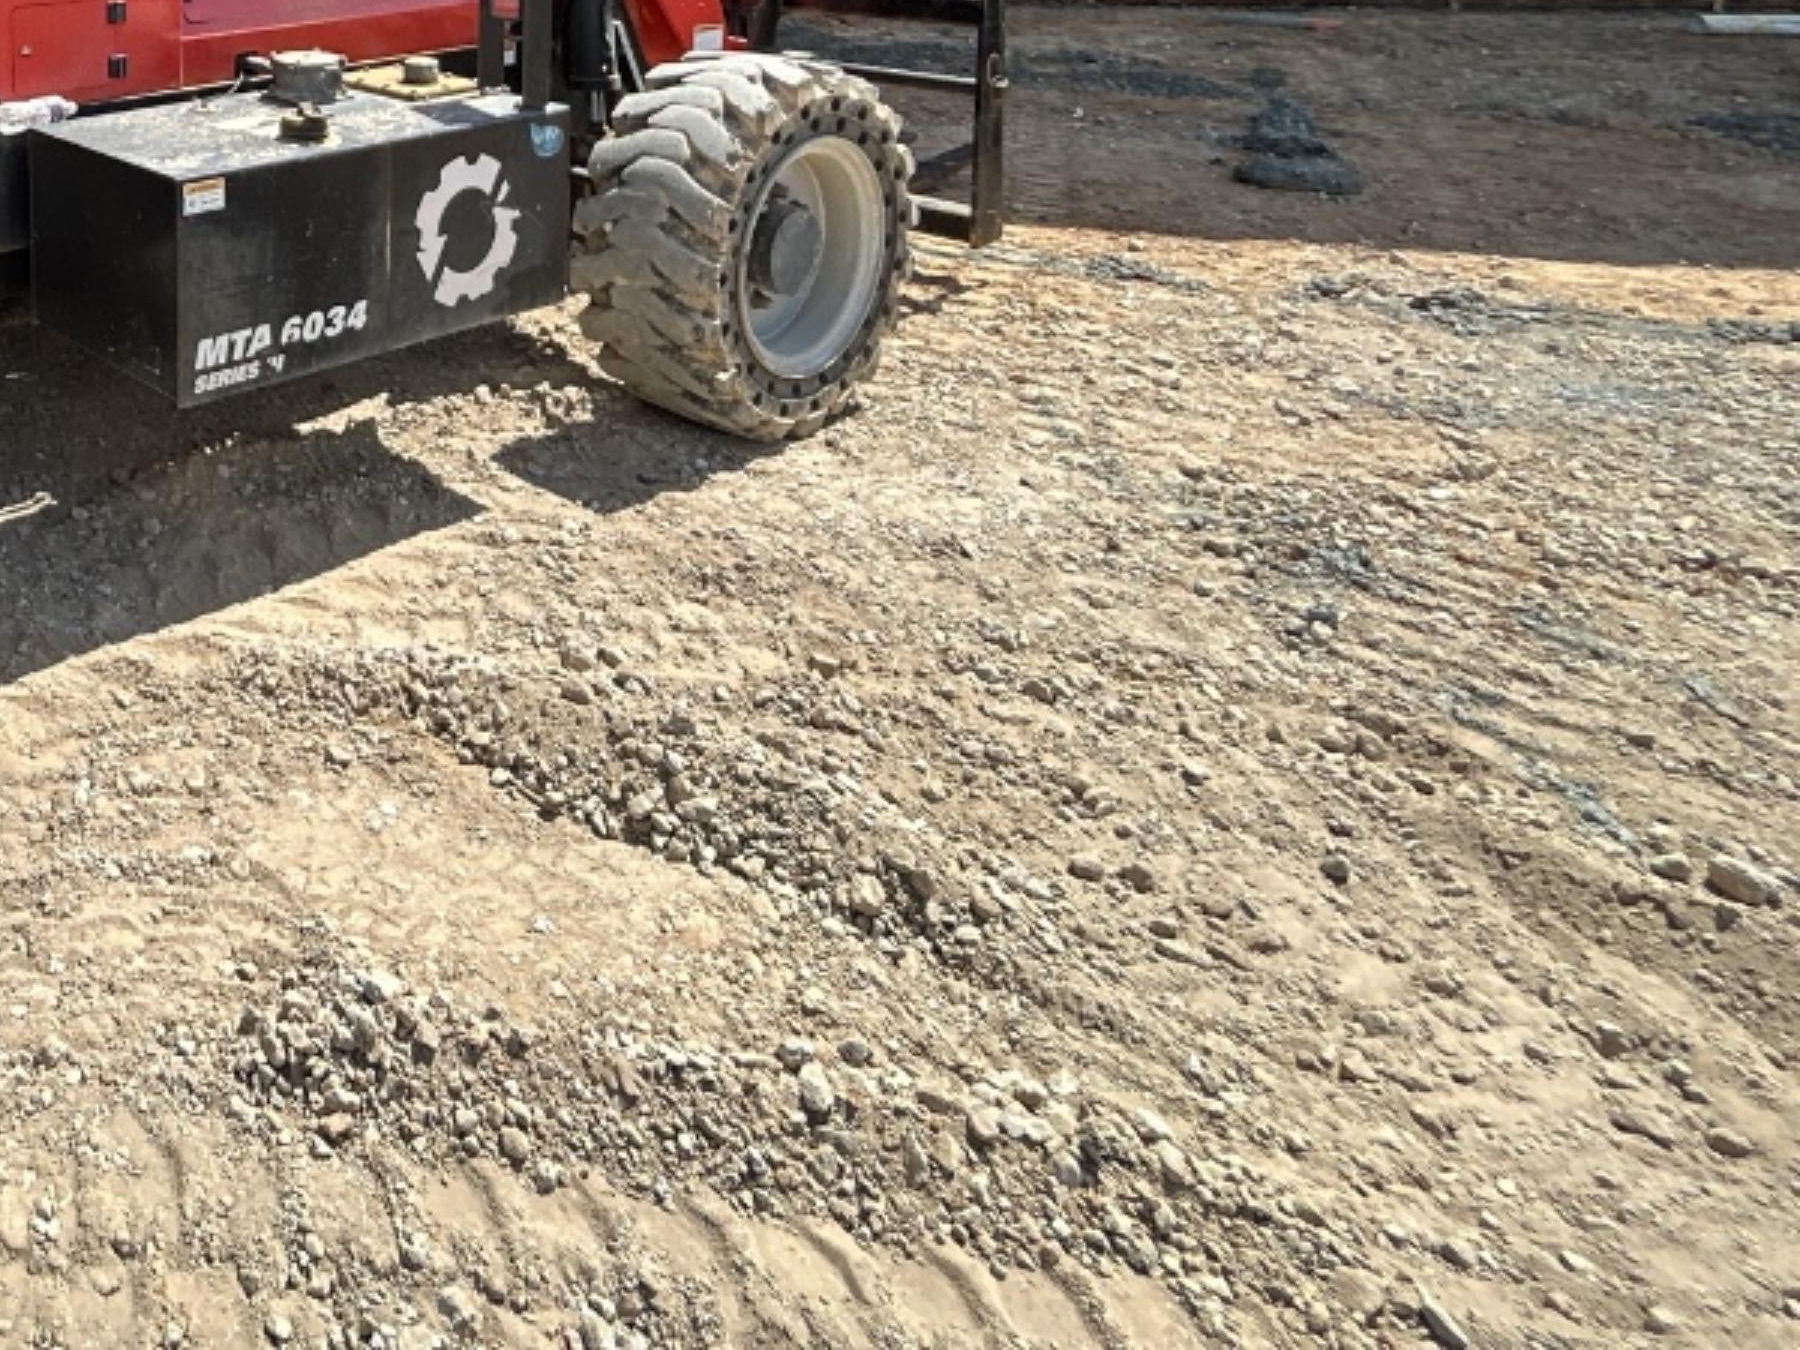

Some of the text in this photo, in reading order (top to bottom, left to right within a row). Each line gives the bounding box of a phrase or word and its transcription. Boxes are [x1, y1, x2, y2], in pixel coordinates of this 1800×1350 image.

[194, 299, 368, 370] MTA 6034
[194, 360, 261, 394] SERIES
